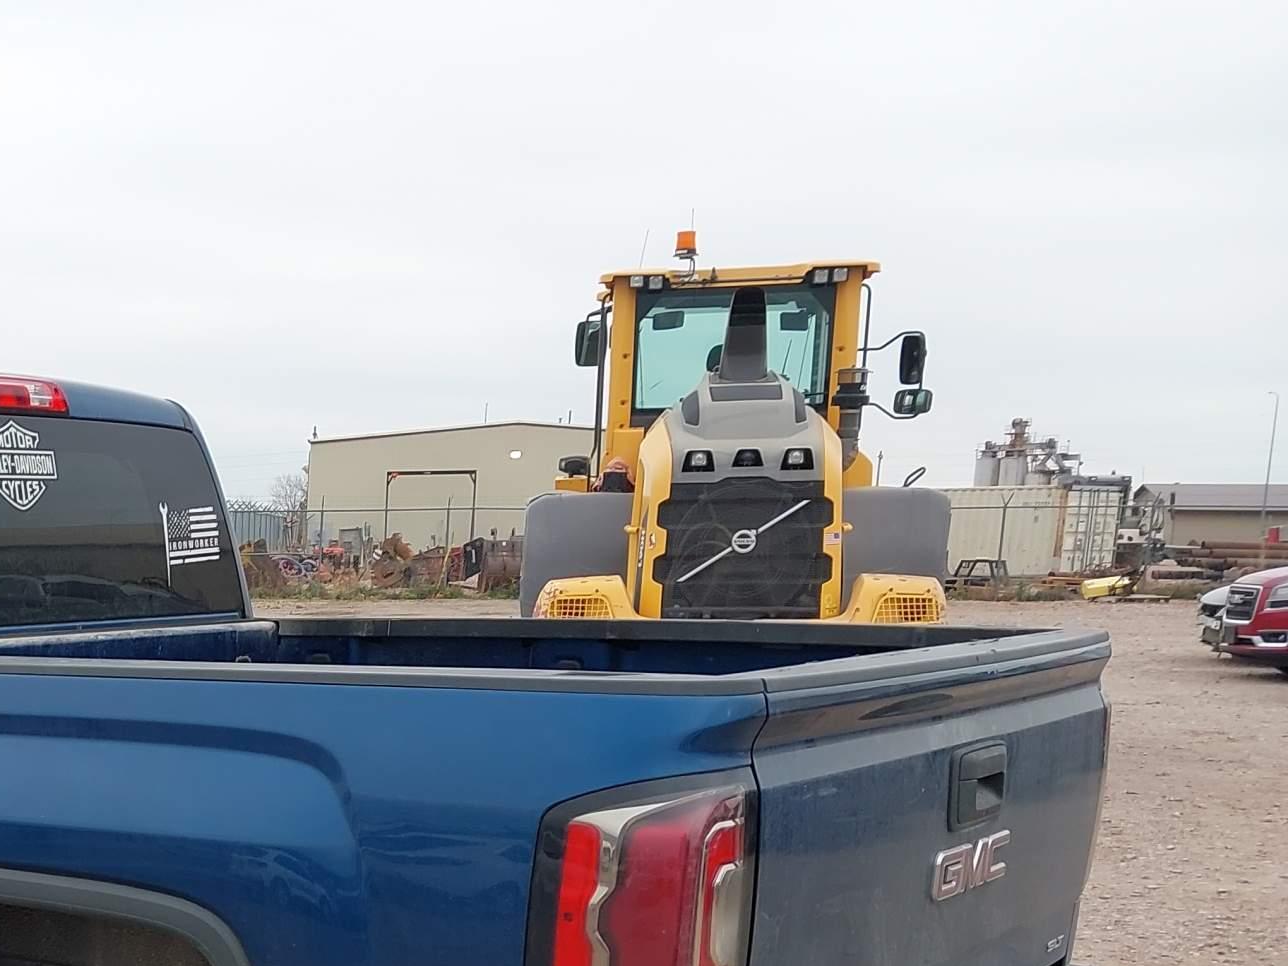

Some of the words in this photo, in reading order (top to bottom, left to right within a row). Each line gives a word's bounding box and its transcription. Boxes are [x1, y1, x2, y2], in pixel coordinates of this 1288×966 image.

[2, 480, 40, 505] CYCLES
[169, 537, 219, 551] IRONWORKER
[932, 829, 1011, 901] GMC
